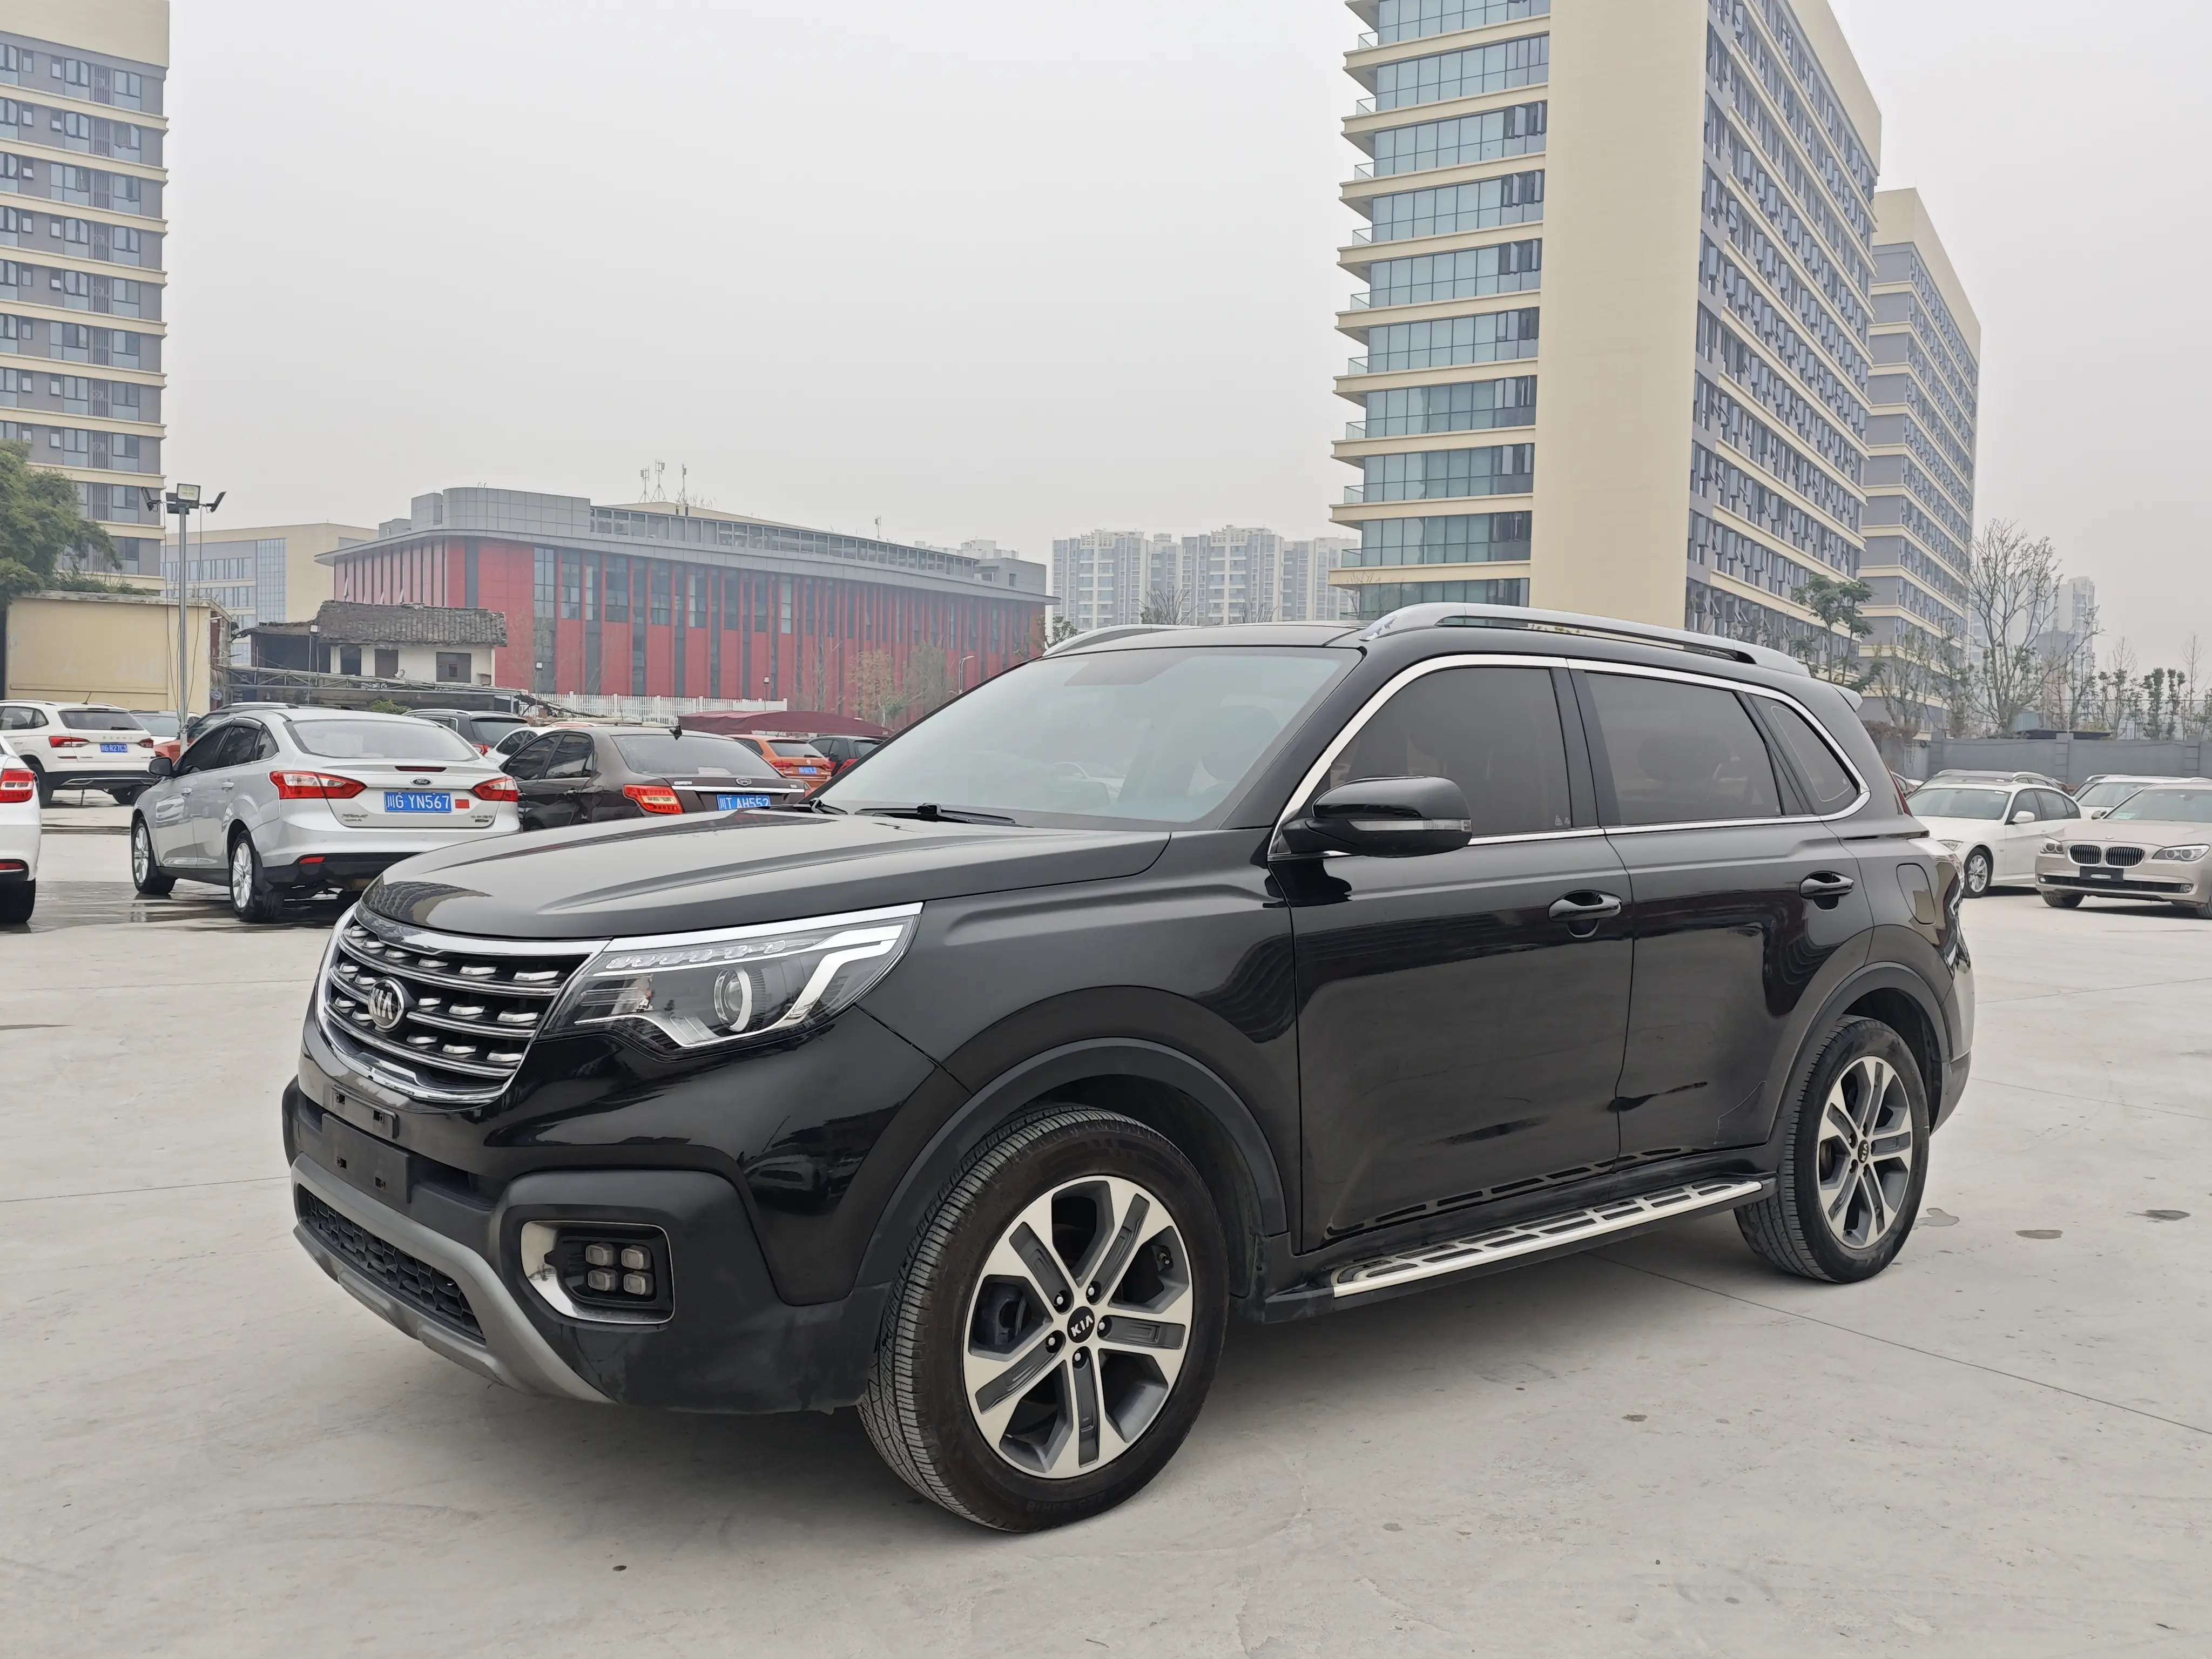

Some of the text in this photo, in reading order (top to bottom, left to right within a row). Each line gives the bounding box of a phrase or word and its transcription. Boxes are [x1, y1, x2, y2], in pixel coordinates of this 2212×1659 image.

[408, 795, 449, 809] YN567
[370, 987, 393, 1020] KIA
[1070, 1315, 1094, 1337] KIA
